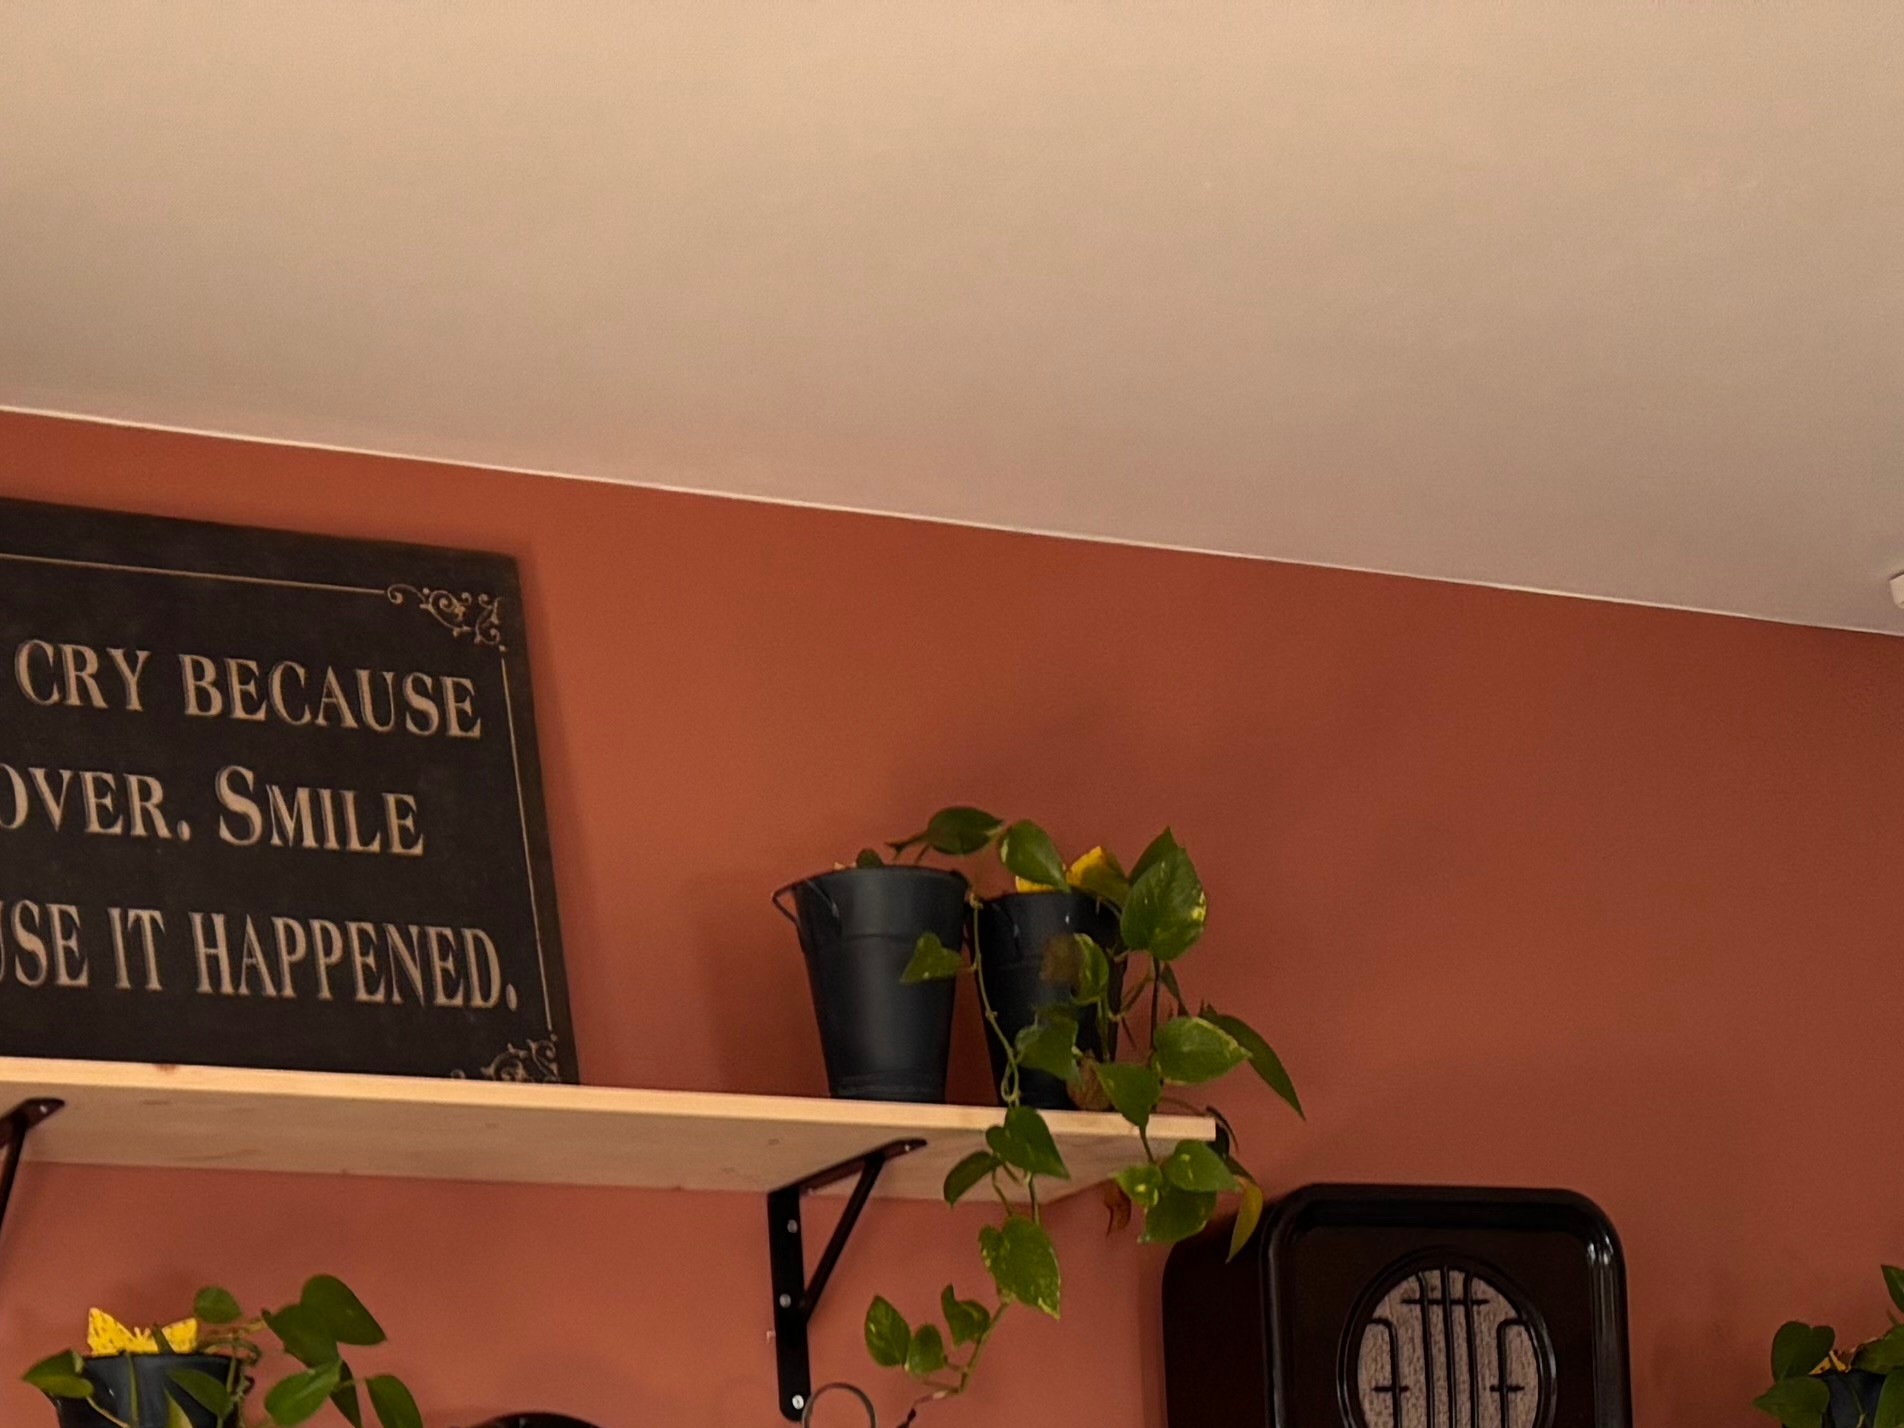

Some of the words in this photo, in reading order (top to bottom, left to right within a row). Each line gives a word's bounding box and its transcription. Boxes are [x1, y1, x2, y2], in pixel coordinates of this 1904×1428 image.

[15, 639, 149, 711] CRY
[179, 654, 481, 738] BECAUSE
[217, 765, 424, 855] SMILE
[108, 907, 165, 991] IT
[191, 912, 517, 1010] HAPPENED.
